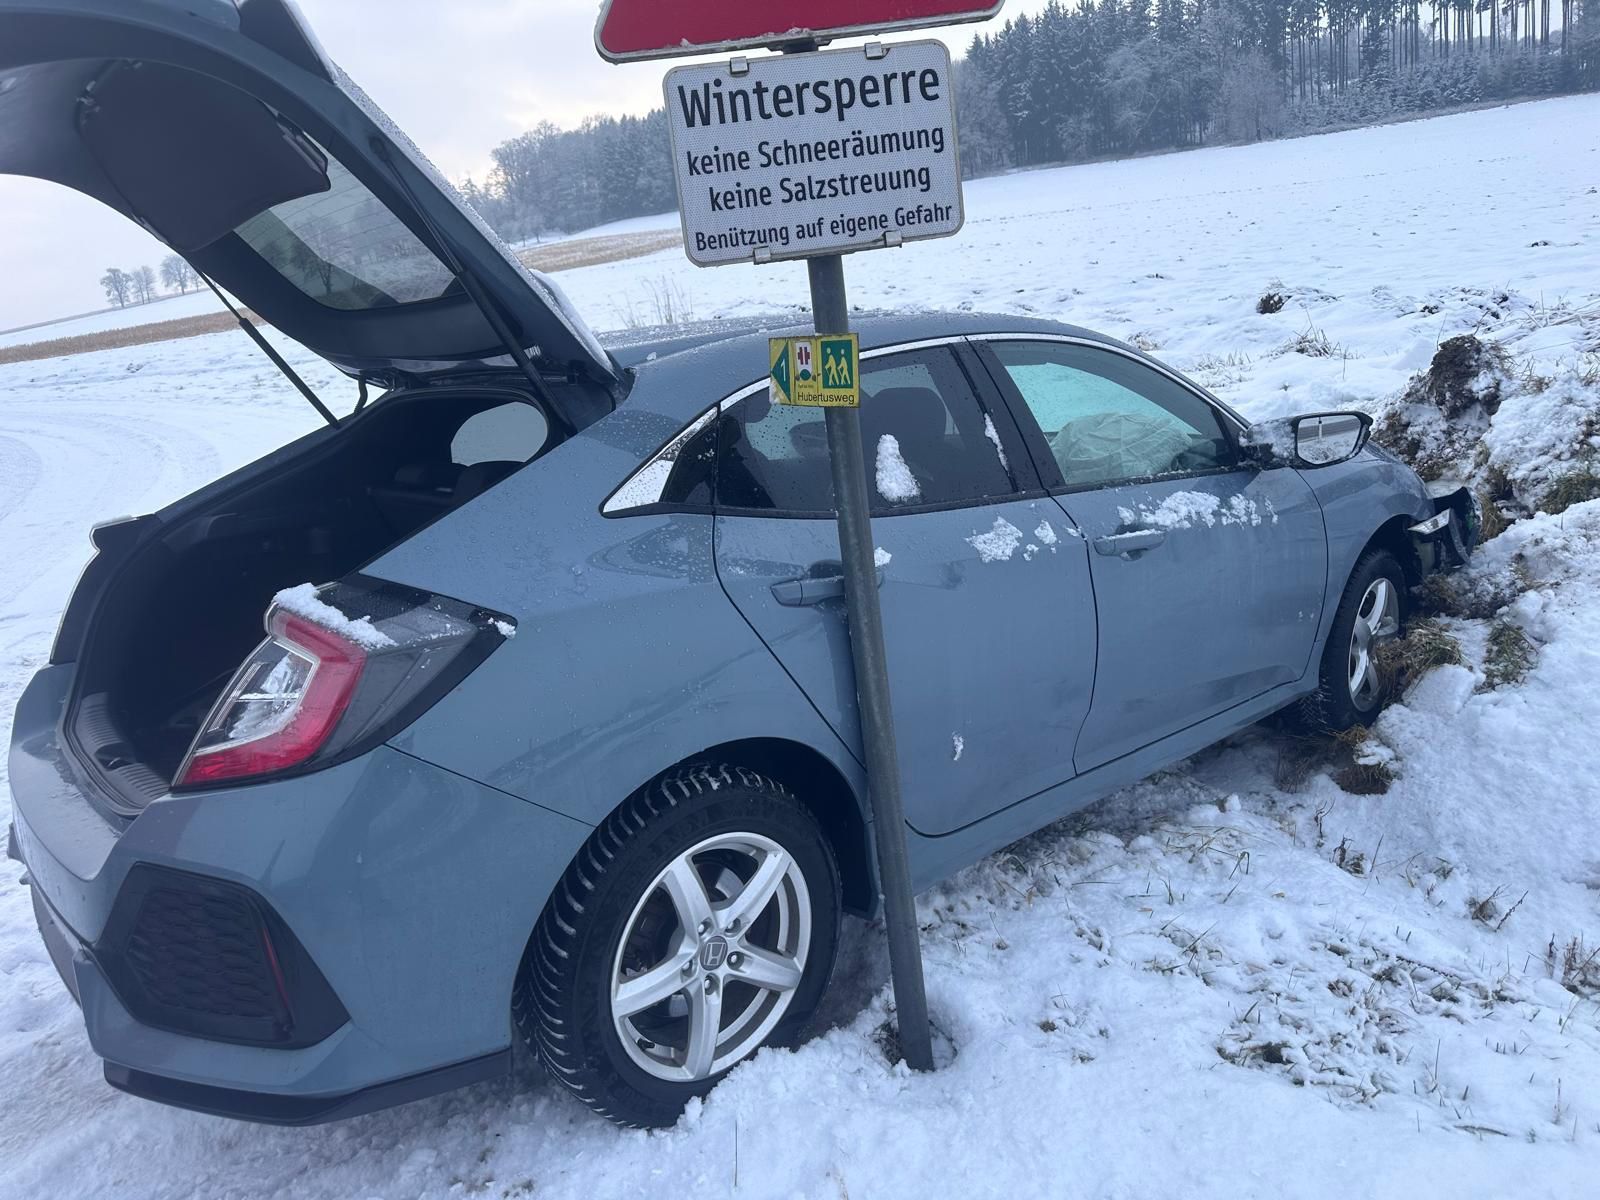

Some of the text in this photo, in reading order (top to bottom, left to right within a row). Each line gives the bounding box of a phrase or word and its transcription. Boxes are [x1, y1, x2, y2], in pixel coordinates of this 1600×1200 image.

[678, 67, 939, 128] Wintersperre
[687, 126, 944, 176] keine Schneeräumung
[709, 166, 931, 212] keine Salzstreuung
[695, 203, 952, 252] Benützung auf eigene Gefahr
[797, 391, 855, 405] Hubertusweg
